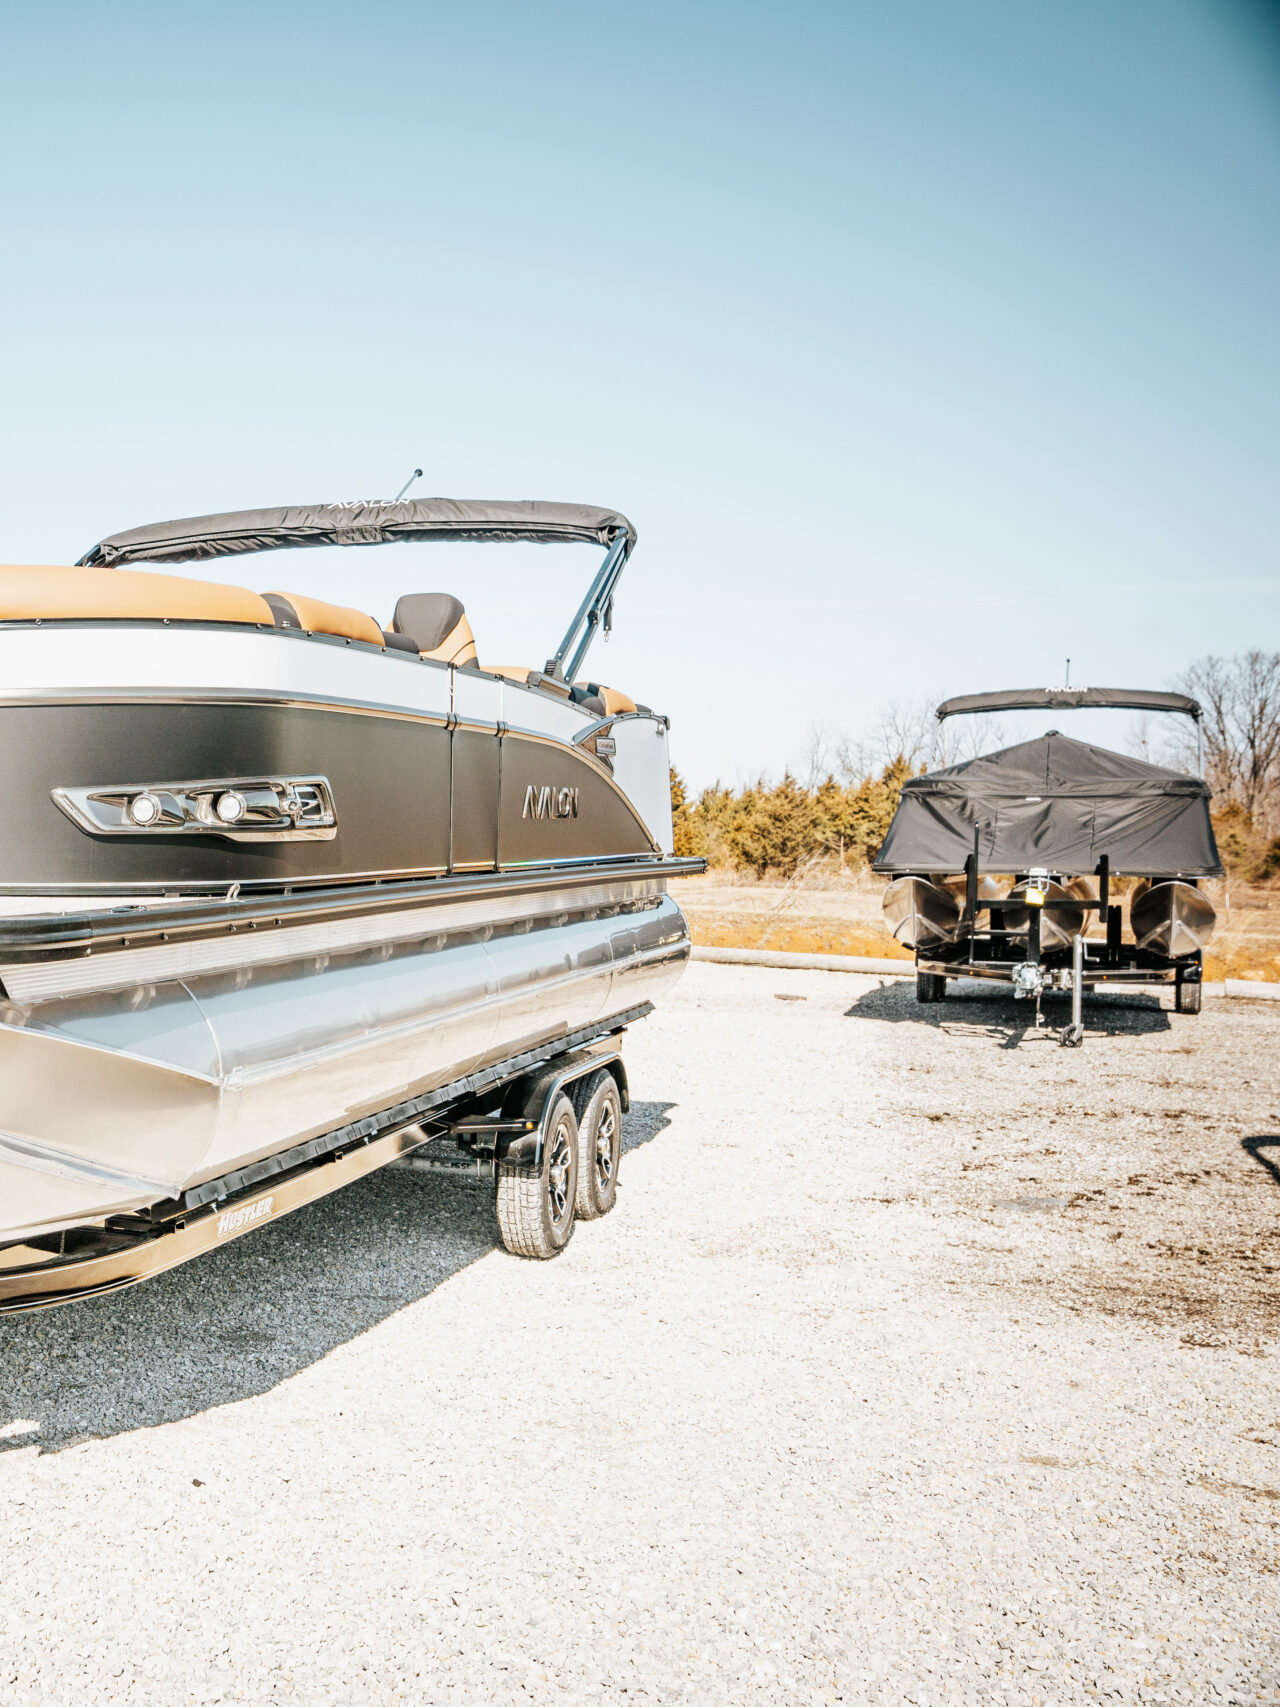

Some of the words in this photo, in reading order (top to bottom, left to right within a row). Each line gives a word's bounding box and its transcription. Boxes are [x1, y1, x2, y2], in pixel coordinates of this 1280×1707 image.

[326, 499, 410, 510] AVALON
[522, 785, 579, 819] AVALON
[217, 1196, 274, 1238] HUSTLER
